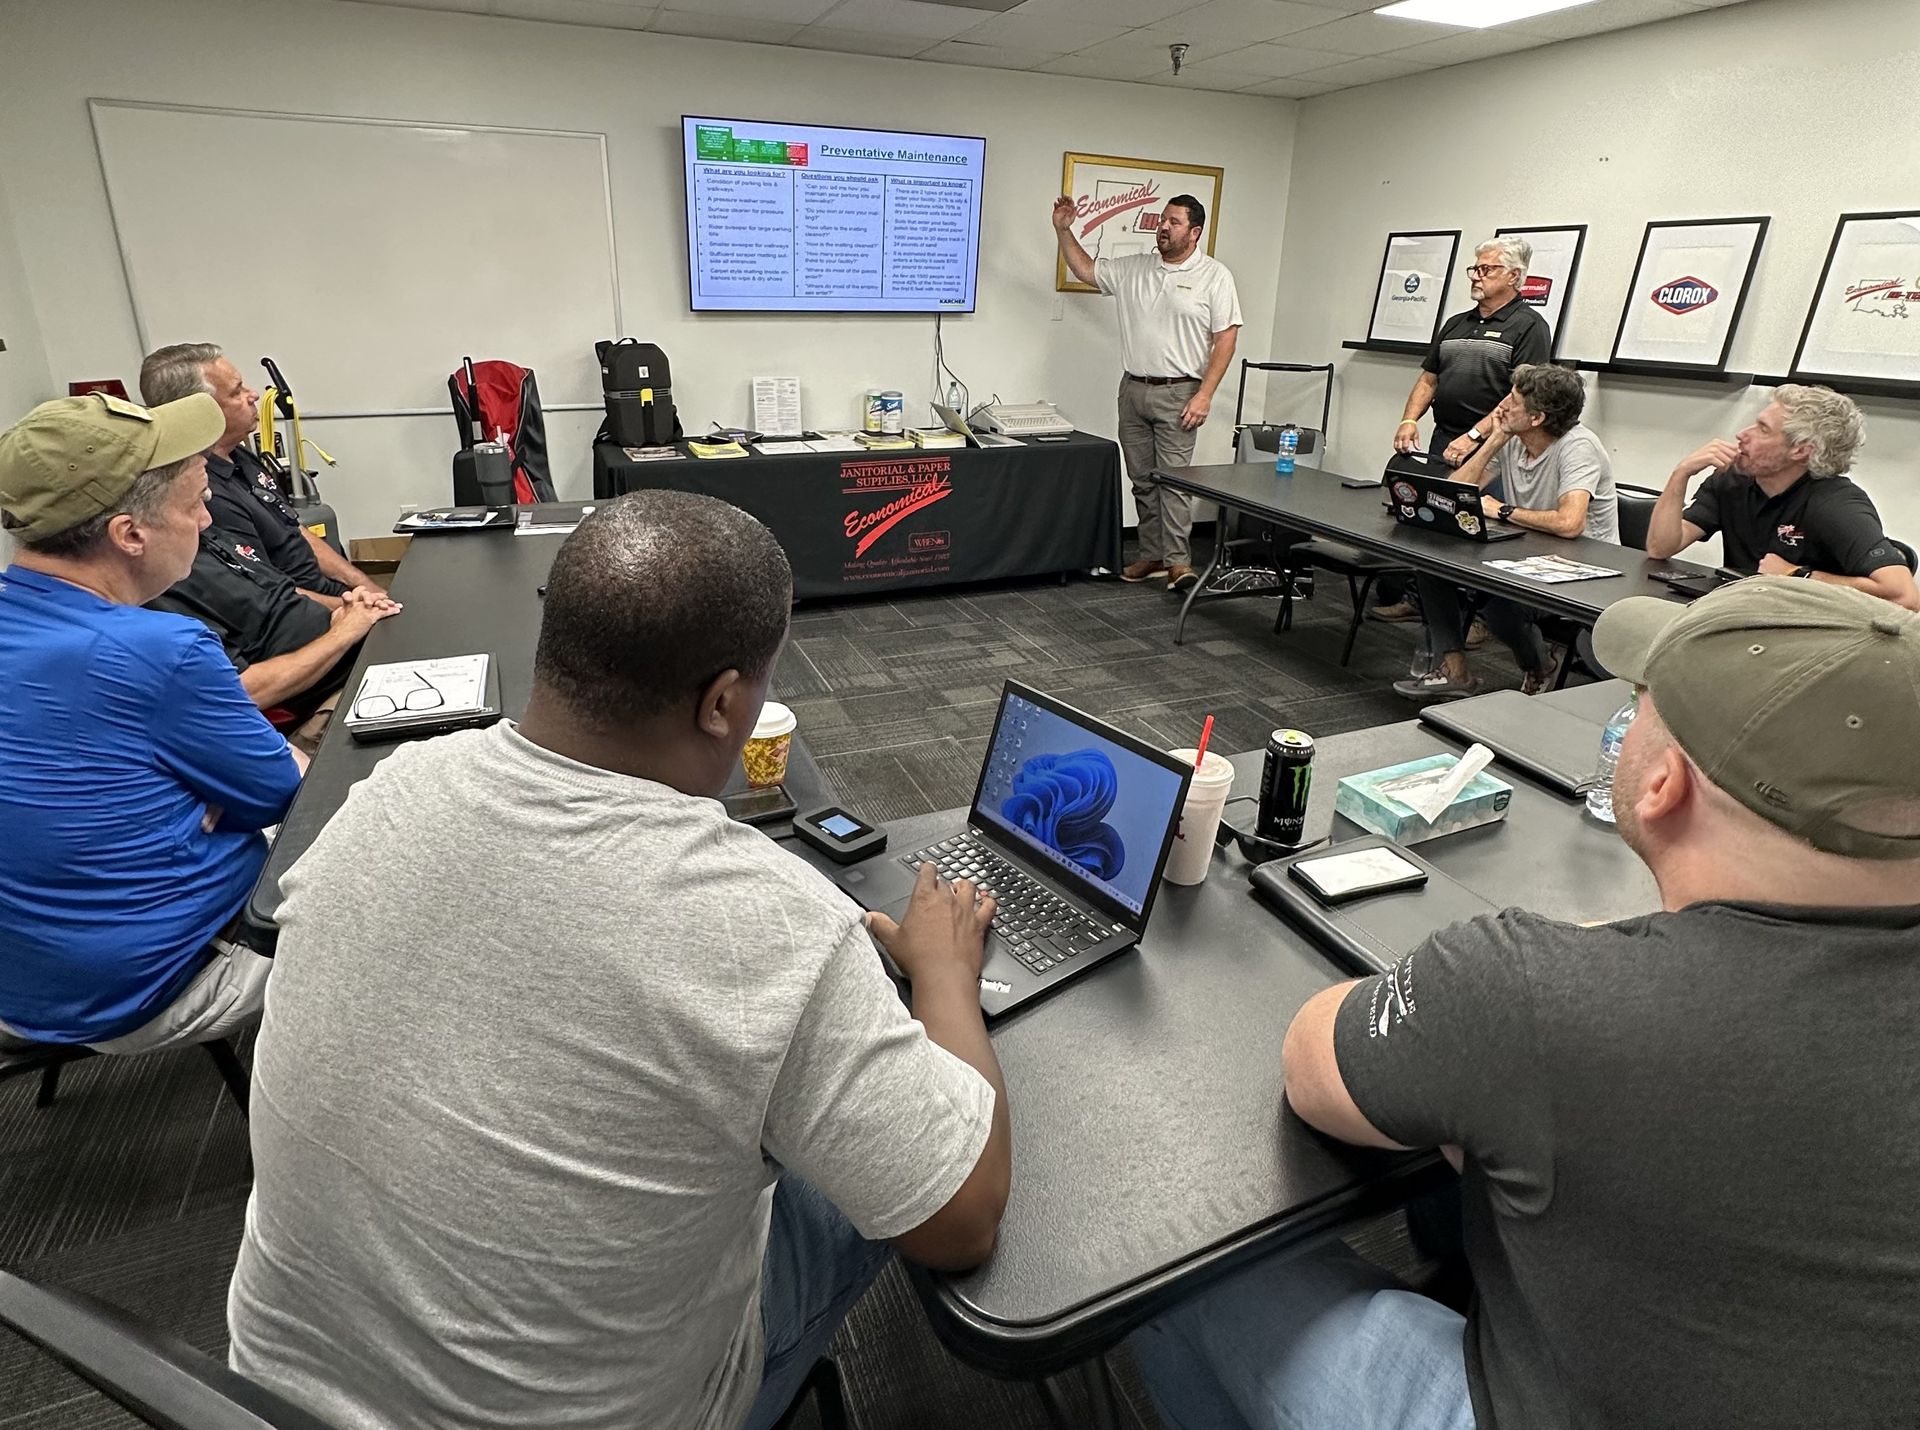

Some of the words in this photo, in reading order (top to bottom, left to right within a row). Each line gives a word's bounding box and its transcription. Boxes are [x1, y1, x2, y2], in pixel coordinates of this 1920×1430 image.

[821, 145, 894, 160] Preventative
[898, 150, 968, 164] Maintenance
[746, 170, 771, 178] looking
[1077, 178, 1160, 218] Economical
[1392, 294, 1428, 302] Georgia-Pacific
[1658, 287, 1710, 304] CLOROX
[840, 464, 905, 478] JANITORIAL
[908, 464, 916, 474] &
[918, 462, 950, 472] PAPER
[912, 473, 933, 484] LLC
[844, 472, 950, 538] Economical
